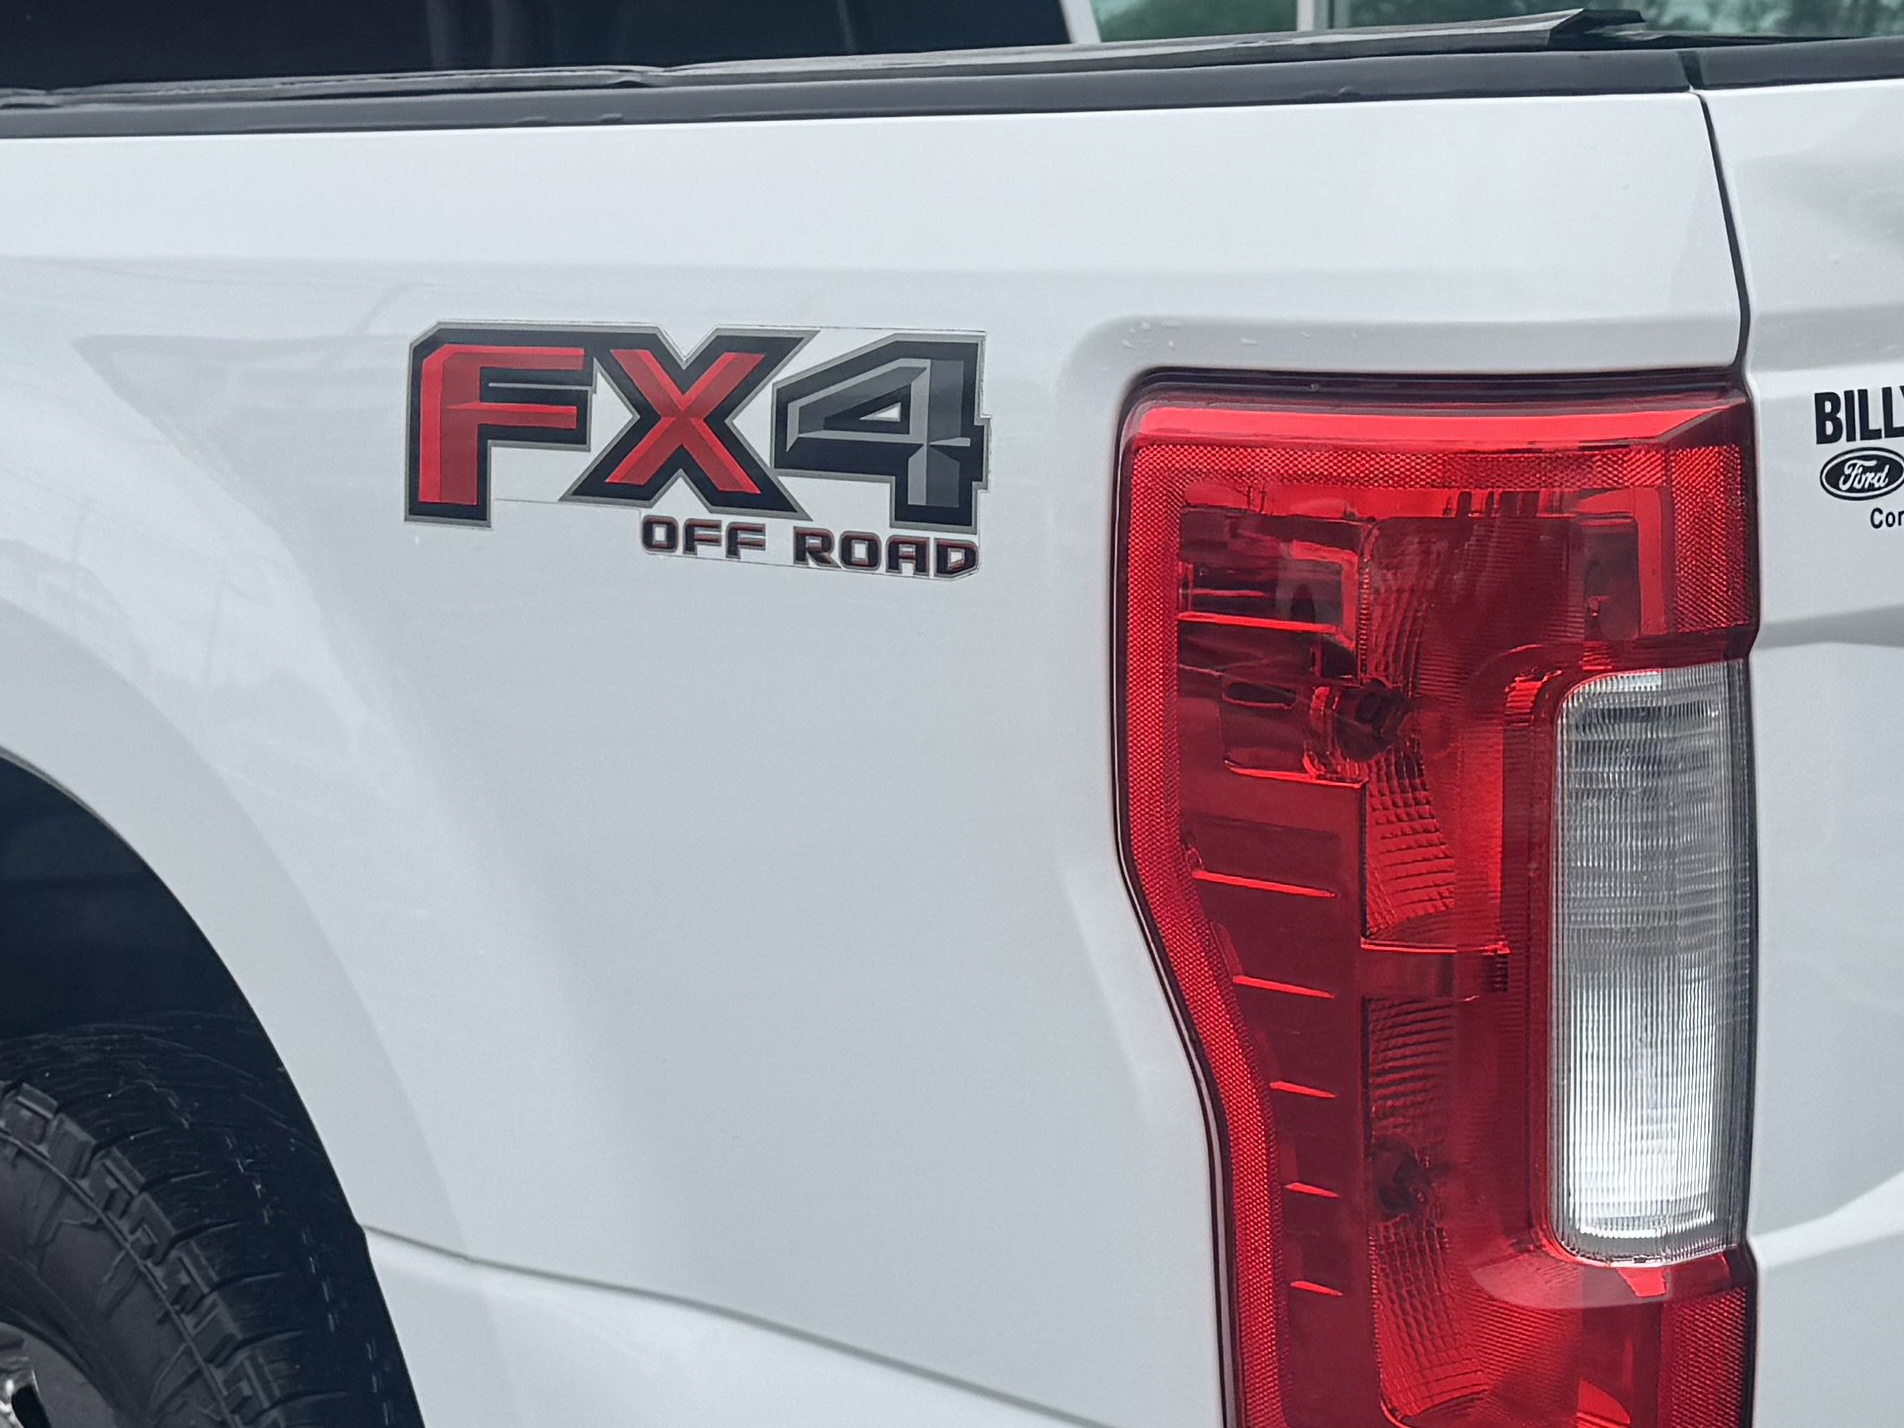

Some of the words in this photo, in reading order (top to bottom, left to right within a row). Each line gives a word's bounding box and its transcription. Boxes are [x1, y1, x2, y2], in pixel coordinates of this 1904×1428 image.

[404, 321, 991, 533] FX4
[1839, 459, 1890, 490] Ford
[641, 515, 767, 560] OFF
[793, 525, 980, 578] ROAD
